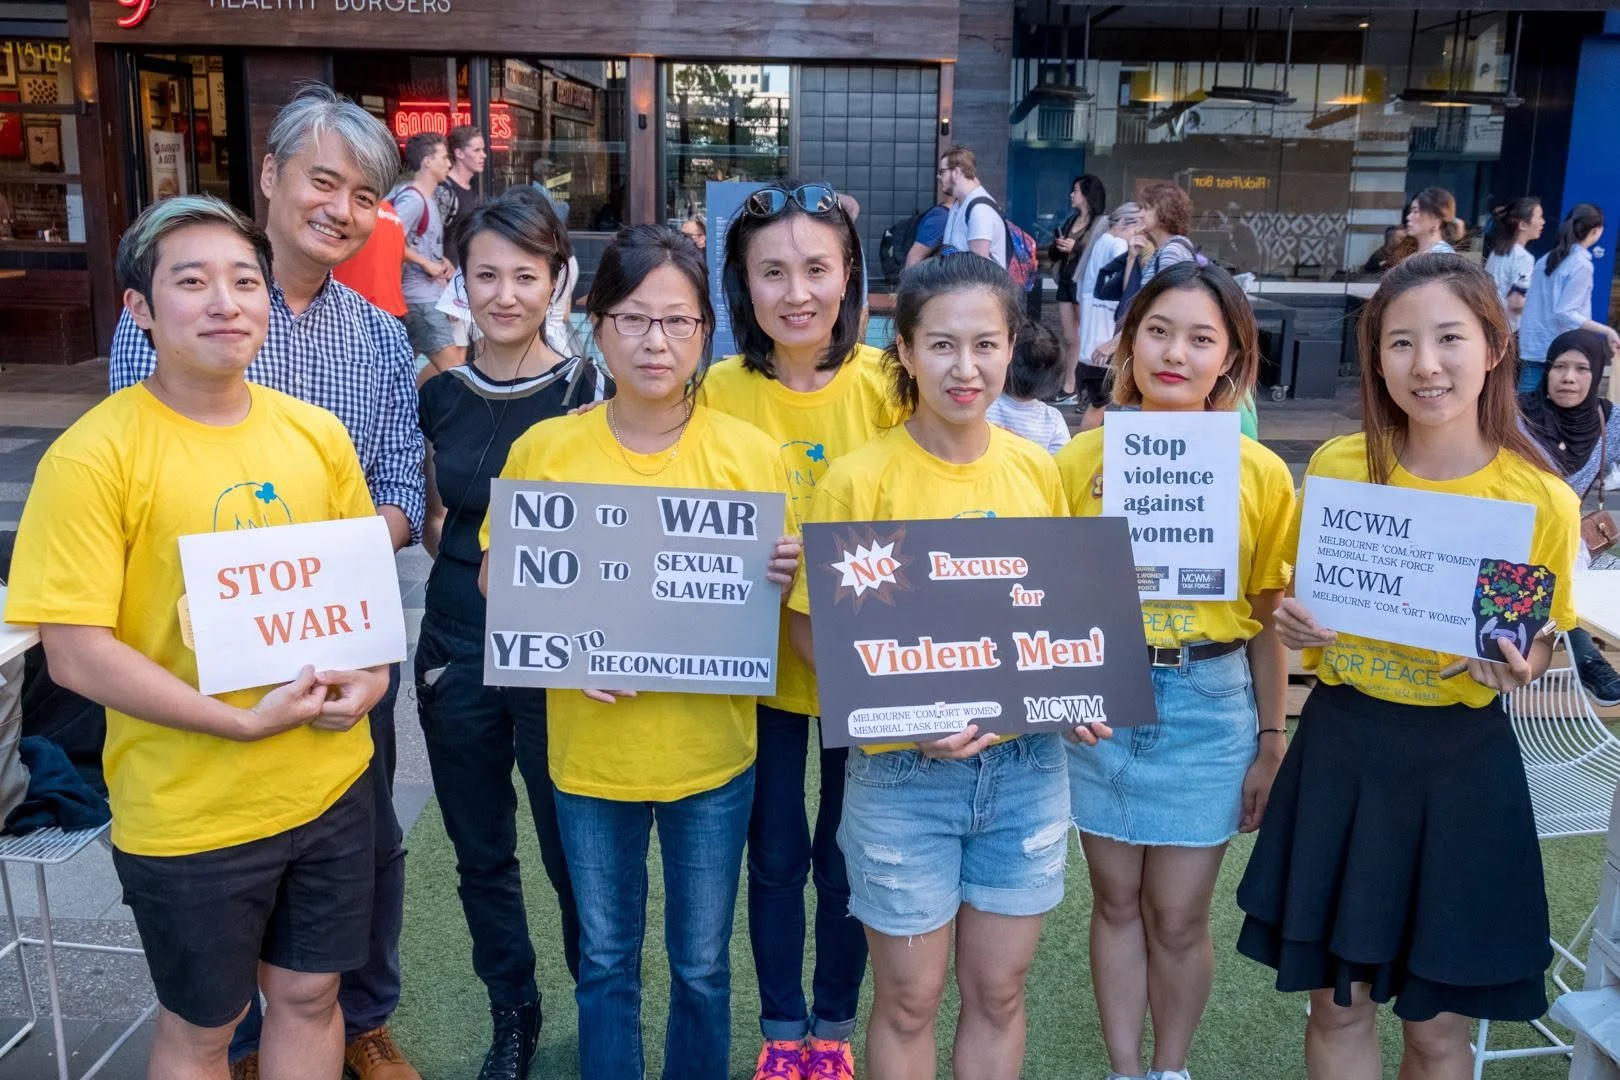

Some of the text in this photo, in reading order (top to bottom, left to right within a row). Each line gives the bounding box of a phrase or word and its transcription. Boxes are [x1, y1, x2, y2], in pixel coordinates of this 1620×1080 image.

[396, 111, 512, 139] GOOD TIES
[1124, 433, 1186, 460] Stop
[1124, 467, 1214, 485] violence
[515, 493, 756, 536] NO TO WAR
[1124, 494, 1205, 515] against
[1130, 526, 1214, 543] women
[1321, 507, 1412, 539] MCWM
[1319, 535, 1379, 552] MELBOURNE
[519, 549, 738, 585] NO TO SEXUAL
[849, 555, 896, 588] No
[934, 554, 1027, 577] Excuse
[1317, 547, 1434, 573] MEMORIAL TASK FORCE
[217, 557, 321, 600] STOP
[1181, 573, 1211, 583] MCWM
[1314, 562, 1404, 597] MCWM
[656, 580, 749, 601] SLAVERY
[1012, 586, 1043, 606] for
[1312, 590, 1371, 609] MELBOURNE
[1142, 611, 1196, 632] PEACE
[492, 631, 605, 669] YES TO
[859, 633, 1103, 674] Violent Men!
[590, 655, 770, 678] RECONCILIATION
[1325, 650, 1440, 687] FOR PEACE
[853, 710, 911, 723] MELBOURNE
[1027, 697, 1106, 721] MCWM
[854, 720, 965, 735] MEMORIAL TASK FORCE
